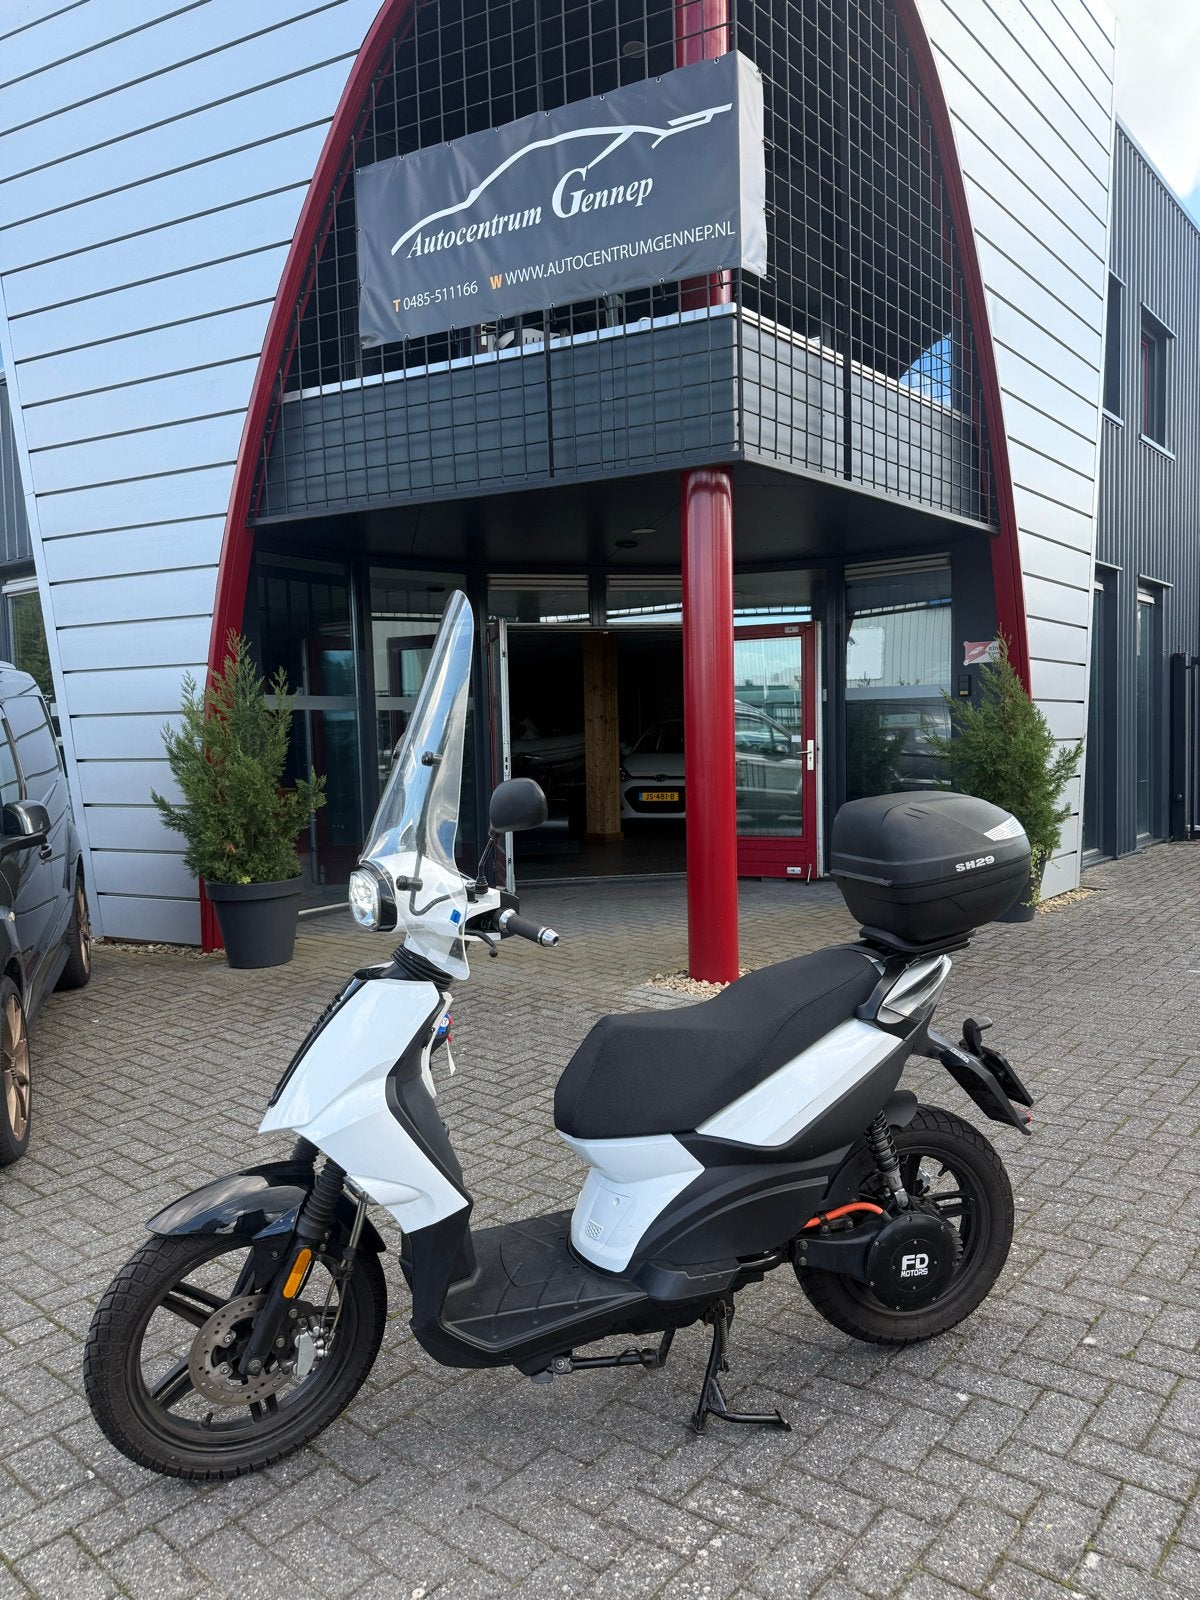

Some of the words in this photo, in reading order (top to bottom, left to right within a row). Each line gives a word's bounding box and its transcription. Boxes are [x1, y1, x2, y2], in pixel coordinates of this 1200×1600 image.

[406, 206, 542, 259] Autocentrum
[552, 166, 654, 218] Gennep
[392, 299, 401, 313] T
[403, 281, 479, 310] 0485-511166
[489, 273, 503, 290] W
[504, 220, 736, 286] WWW.AUTOCENTRUMGENNEP.NL
[955, 855, 995, 872] SH29
[901, 1253, 929, 1271] FD
[900, 1268, 929, 1278] MOTORS
